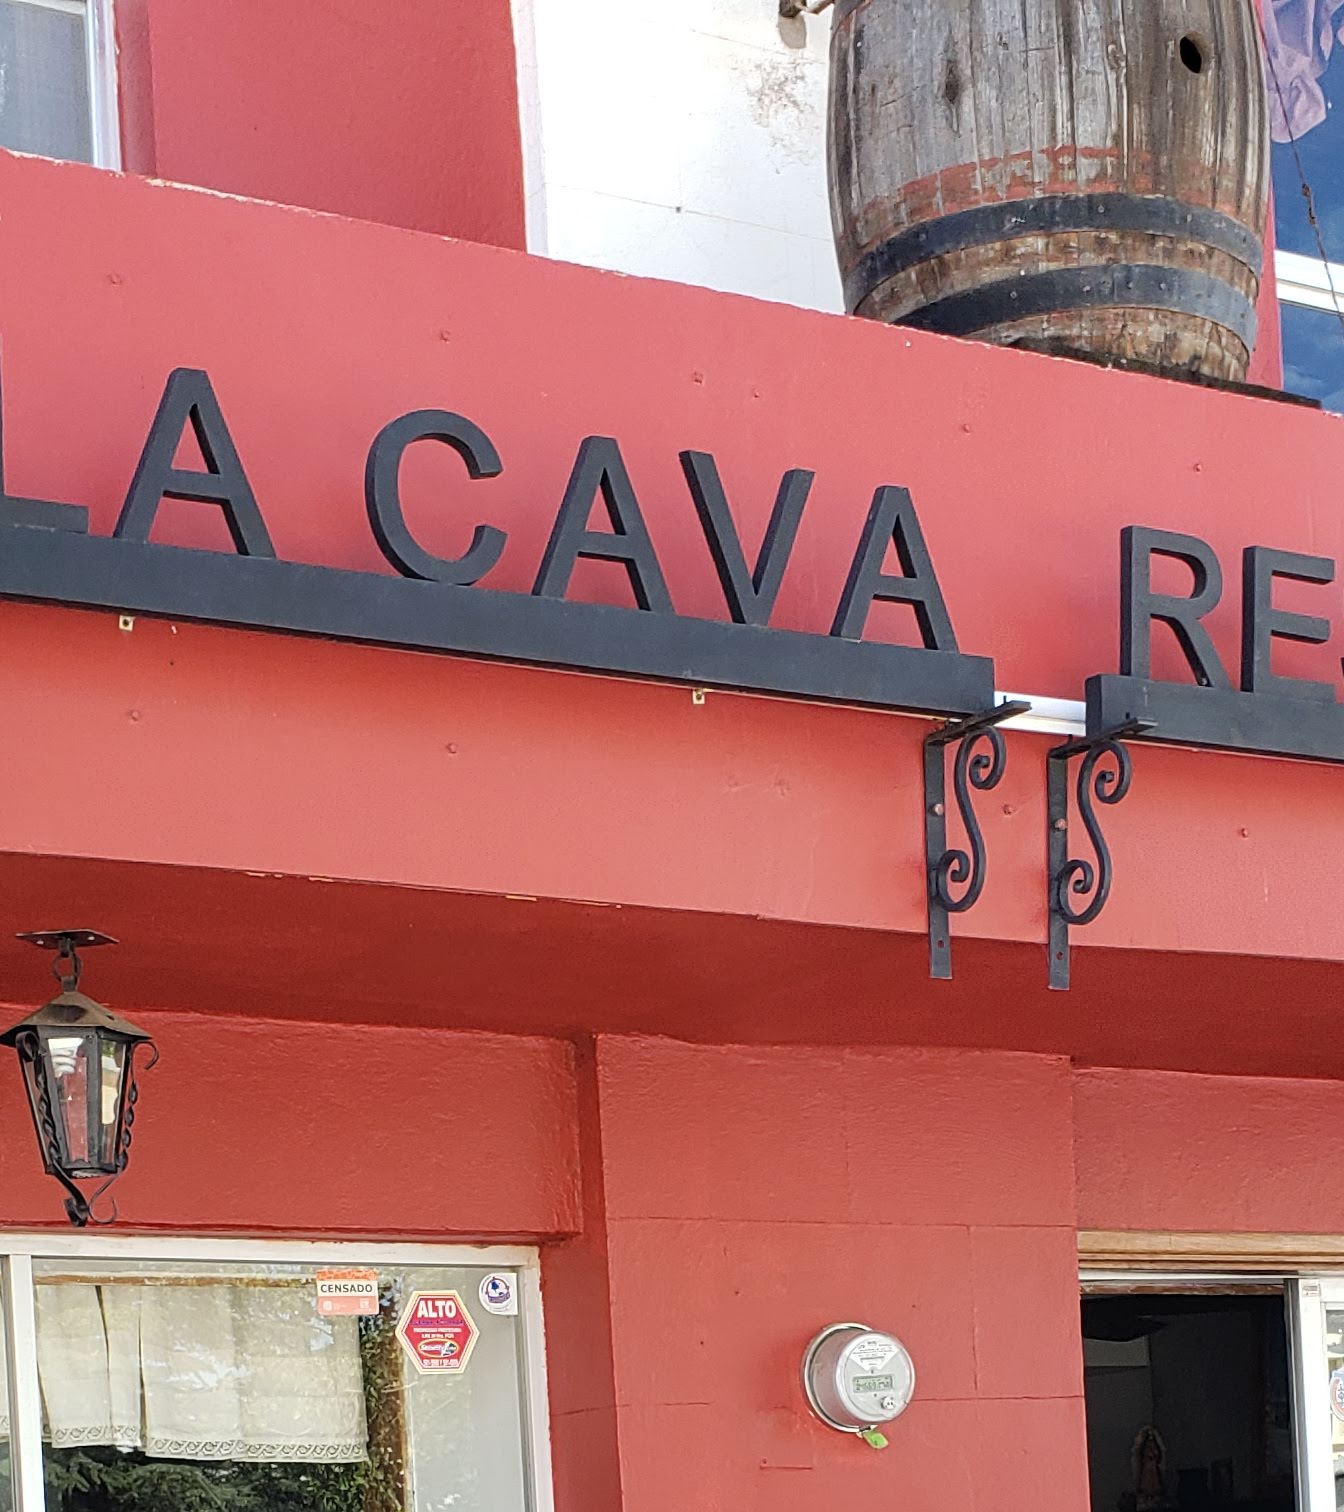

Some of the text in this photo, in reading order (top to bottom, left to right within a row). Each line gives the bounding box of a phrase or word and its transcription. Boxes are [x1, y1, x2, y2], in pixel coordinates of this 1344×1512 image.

[364, 407, 957, 652] CAVA
[320, 1283, 373, 1293] CENSADO
[417, 1300, 457, 1318] ALTO
